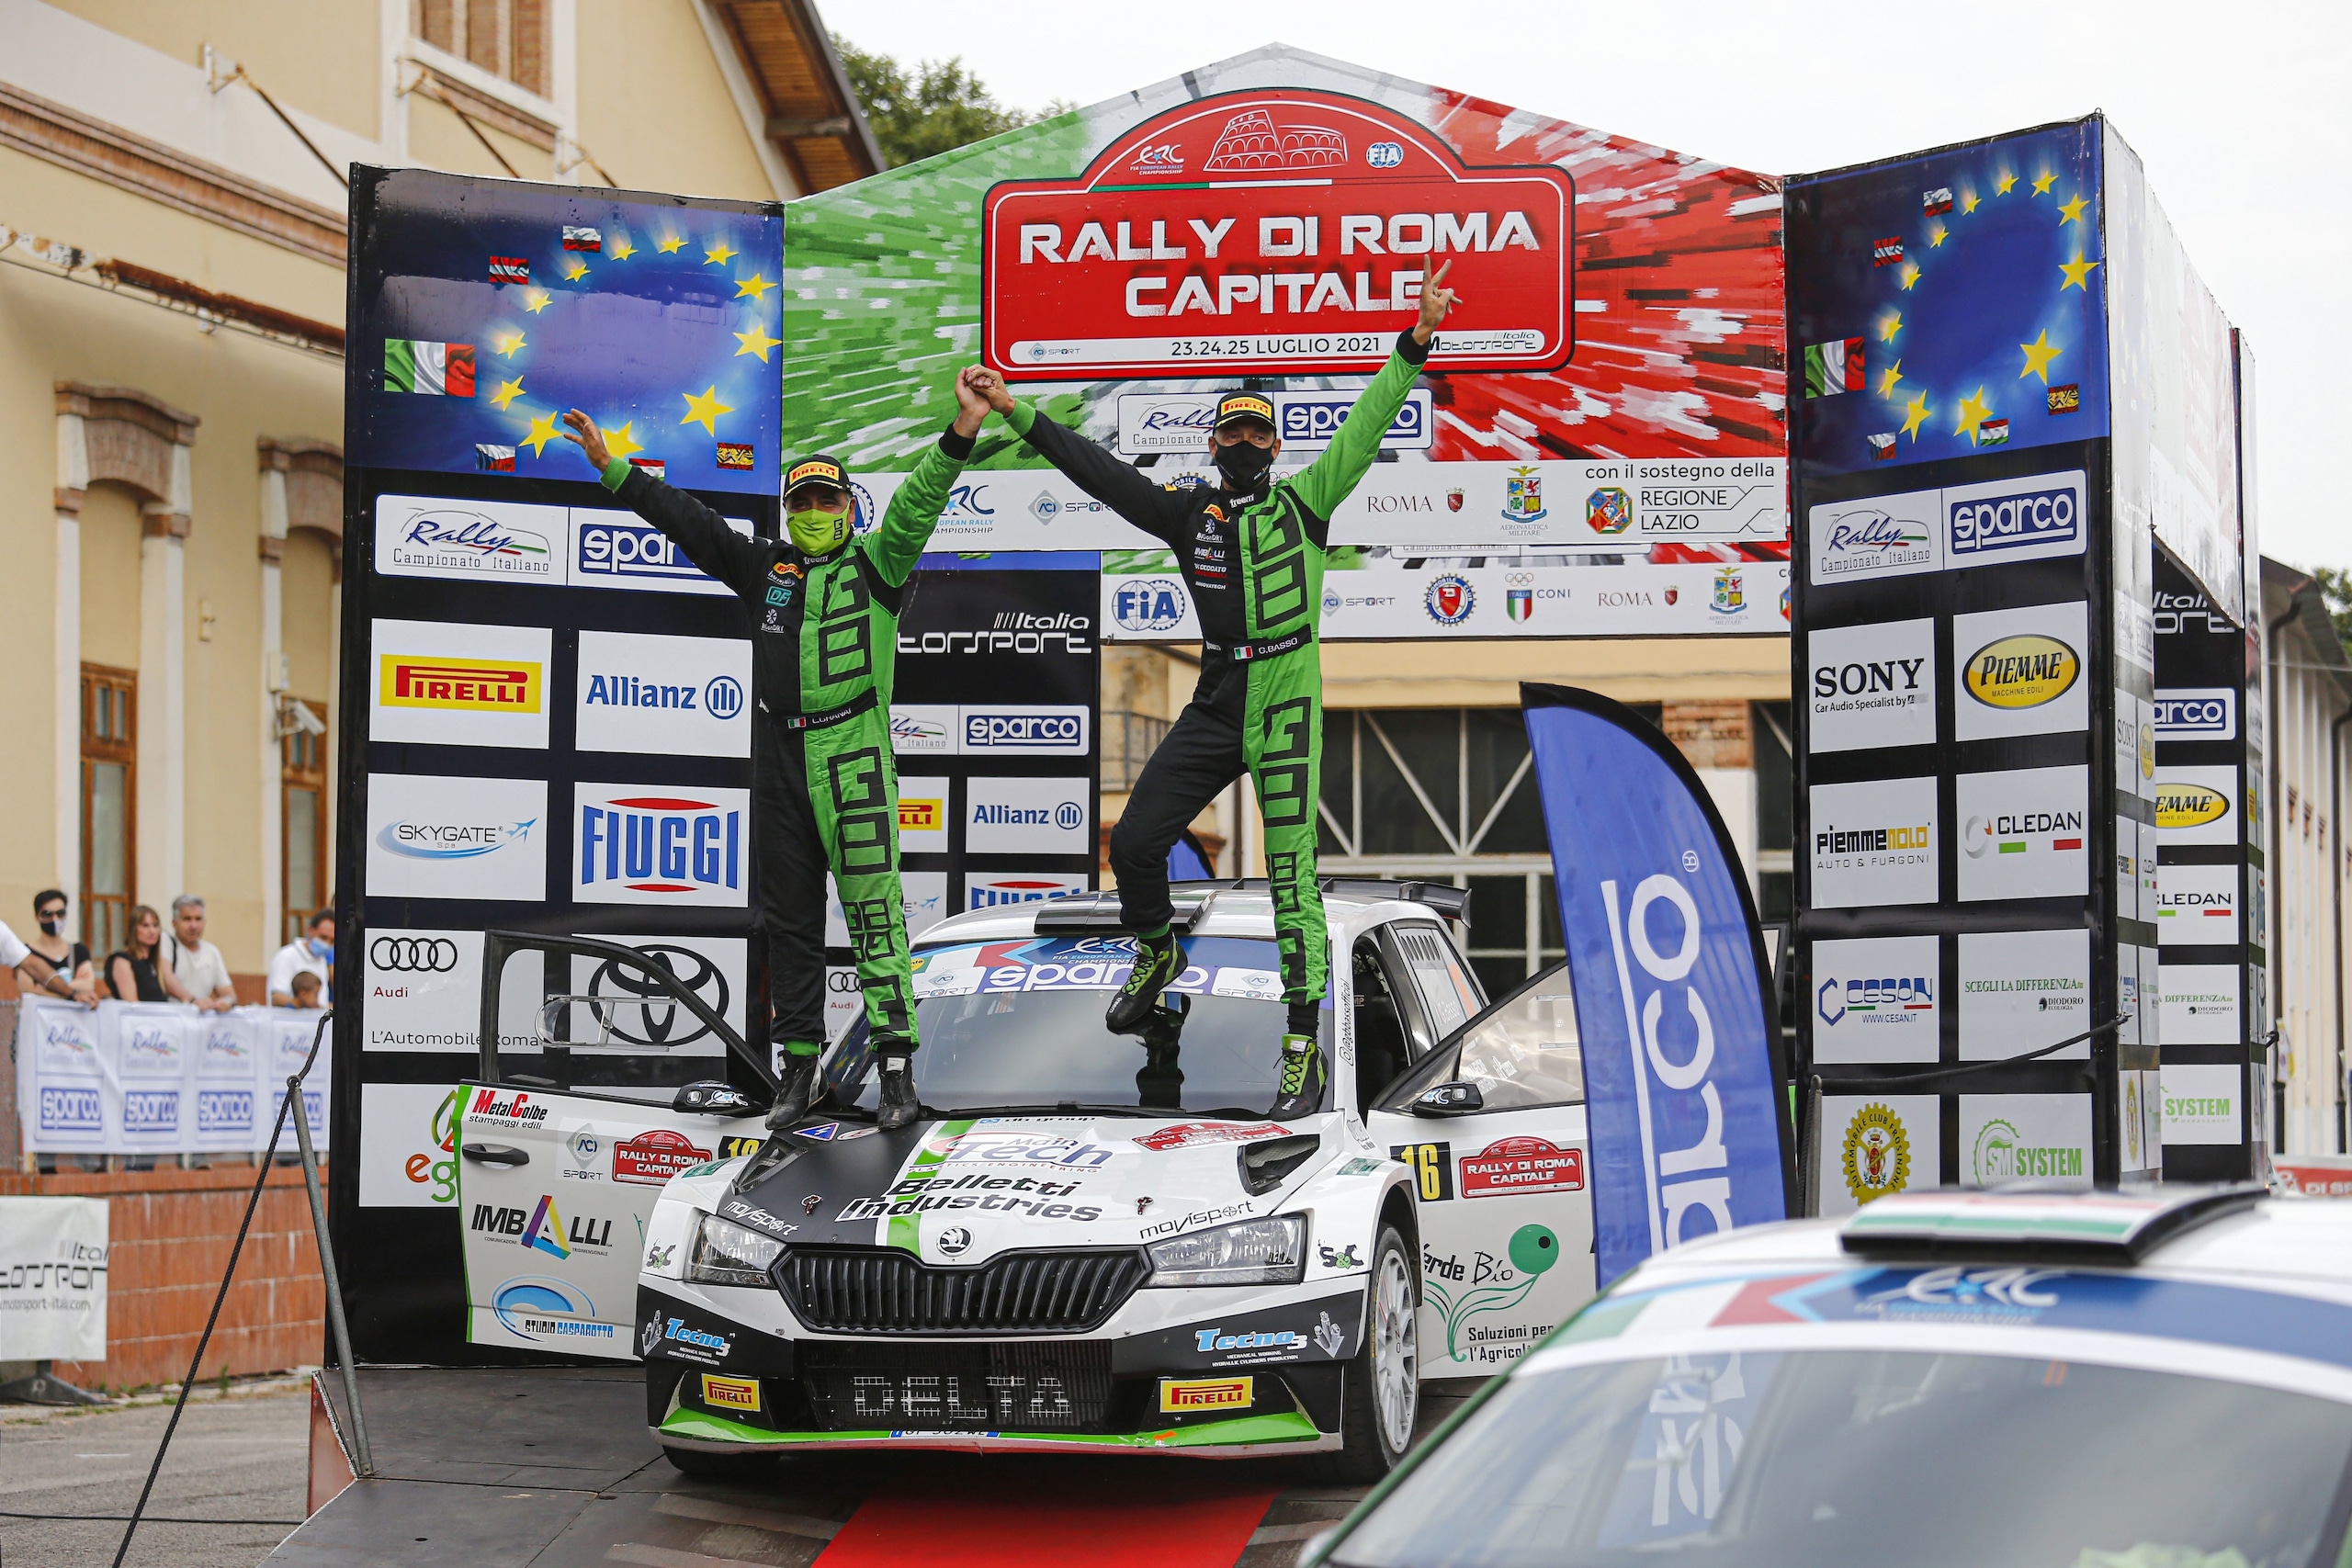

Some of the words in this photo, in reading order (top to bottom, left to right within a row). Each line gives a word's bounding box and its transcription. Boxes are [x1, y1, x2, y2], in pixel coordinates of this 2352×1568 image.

[1020, 218, 1236, 264] RALLY
[1260, 216, 1317, 257] DI
[1340, 211, 1539, 254] ROMA
[1125, 270, 1423, 317] CAPITALE
[1502, 332, 1535, 340] Italia
[1171, 340, 1250, 356] 23.24.25
[1256, 338, 1330, 355] LUGLIO
[1336, 337, 1380, 354] 2021
[1134, 434, 1203, 446] Campionato
[1586, 468, 1619, 479] con
[1625, 465, 1634, 479] il
[1640, 464, 1724, 480] sostegno
[1731, 462, 1774, 477] della
[1229, 494, 1255, 508] freem
[1366, 494, 1433, 513] ROMA
[1642, 490, 1727, 506] REGIONE
[1065, 502, 1112, 513] SPOR
[1642, 514, 1699, 530] LAZIO
[1954, 493, 2073, 550] sparco
[406, 520, 514, 556] Rally
[1828, 517, 1905, 552] Rally
[393, 548, 481, 568] Campionato
[493, 557, 549, 572] Italiano
[1821, 553, 1881, 573] Campionato
[1889, 549, 1930, 564] Italiano
[1345, 597, 1396, 606] SPORT
[1536, 589, 1570, 599] CONI
[1599, 592, 1653, 606] ROMA
[1016, 613, 1091, 629] Italia
[897, 632, 1092, 654] torsport
[1259, 637, 1298, 655] G.BASSO
[1815, 658, 1925, 698] SONY
[1980, 651, 2063, 688] PIEMME
[395, 665, 528, 704] PIRELLI
[586, 674, 696, 709] Allianz
[1992, 687, 2026, 698] MACCHINE
[2027, 685, 2044, 695] EDILI
[1815, 701, 1828, 714] Car
[1830, 699, 1854, 713] Audio
[1855, 697, 1894, 711] Specialist
[1895, 696, 1906, 710] by
[2154, 701, 2222, 724] arco
[969, 717, 1079, 746] sparco
[908, 739, 946, 749] Italiano
[2155, 795, 2212, 813] EMME
[974, 805, 1049, 825] Allianz
[1997, 811, 2082, 835] CLEDAN
[582, 804, 741, 890] FIUGGI
[1817, 859, 1850, 869] AUTO
[1858, 858, 1864, 867] &
[1871, 854, 1929, 866] FURGONI
[2158, 893, 2232, 906] LEDAN
[374, 986, 409, 998] Audi
[1217, 987, 1282, 1000] SPOR
[1847, 977, 1932, 1004] CESAN
[1965, 979, 1999, 993] SCEGLI
[2000, 979, 2014, 992] LA
[831, 1001, 854, 1010] Audi
[2048, 997, 2084, 1006] DIODORO
[1861, 1012, 1917, 1023] WWW.CESAN.IT
[472, 1089, 548, 1121] MetalColbe
[2165, 1098, 2230, 1116] SYSTEM
[469, 1115, 519, 1129] stampaggi
[522, 1121, 542, 1130] edili
[1007, 1137, 1079, 1146] Main
[1161, 1131, 1281, 1150] COMPETITOR
[619, 1150, 656, 1162] RALLY
[660, 1154, 671, 1163] DI
[673, 1156, 706, 1166] ROMA
[948, 1141, 1113, 1166] Tech
[1849, 1117, 1868, 1190] AUTOMOBILE
[1869, 1112, 1888, 1125] CLUB
[1889, 1123, 1904, 1192] FROSINONE
[909, 1162, 978, 1172] PLASTICS
[989, 1162, 1098, 1173] ENGINEERING
[1466, 1161, 1513, 1175] RALLY
[1518, 1160, 1531, 1171] DI
[1534, 1157, 1576, 1169] ROMA
[2016, 1147, 2083, 1177] SYSTEM
[563, 1169, 604, 1180] SPORT
[1490, 1170, 1555, 1185] CAPITALE
[887, 1175, 1082, 1197] Belletti
[836, 1194, 1102, 1223] Industries
[1139, 1200, 1254, 1240] movisport
[484, 1236, 517, 1245] COMUNICAZIONE
[572, 1247, 608, 1257] TRIDIMENSIONALE
[1470, 1250, 1513, 1286] Bio
[525, 1319, 556, 1334] STUDIO
[557, 1322, 614, 1338] GASPAROTTO
[1468, 1325, 1527, 1341] Soluzioni
[707, 1381, 752, 1404] PIRELLI
[854, 1376, 1073, 1419] DELTA
[1171, 1383, 1244, 1405] PIRELLI
